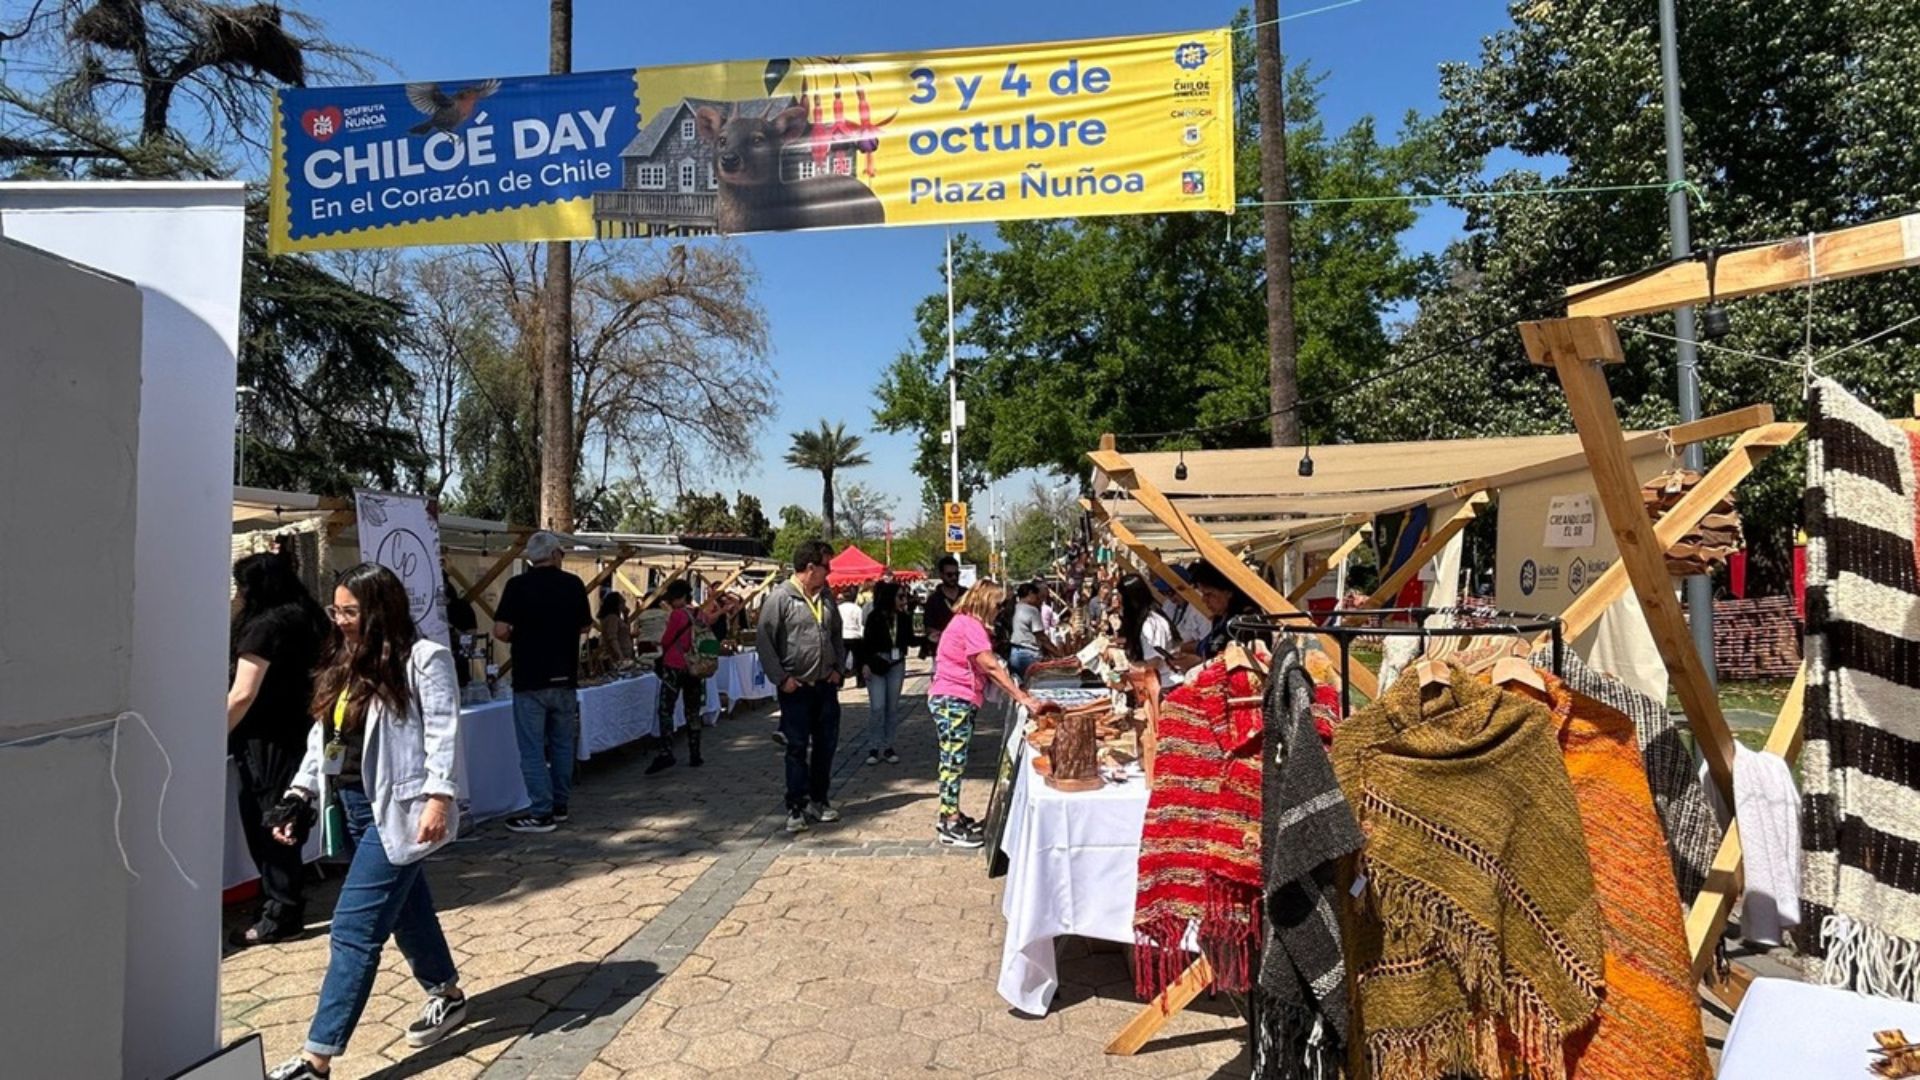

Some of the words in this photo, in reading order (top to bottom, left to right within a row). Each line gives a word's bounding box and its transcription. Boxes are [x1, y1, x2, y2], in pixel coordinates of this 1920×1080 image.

[909, 67, 937, 105] 3
[954, 74, 982, 111] y
[1000, 62, 1032, 97] 4
[1050, 59, 1111, 97] de
[343, 104, 385, 117] DISFRUTA
[345, 113, 387, 129] ÑUÑOA
[303, 111, 497, 190] CHILOÉ
[512, 101, 617, 160] DAY
[908, 114, 1107, 156] octubre
[311, 198, 342, 220] En
[350, 191, 374, 214] el
[381, 175, 490, 210] Corazón
[498, 170, 532, 193] de
[540, 158, 612, 187] Chile
[909, 175, 1006, 205] Plaza
[1020, 162, 1145, 199] Ñuñoa
